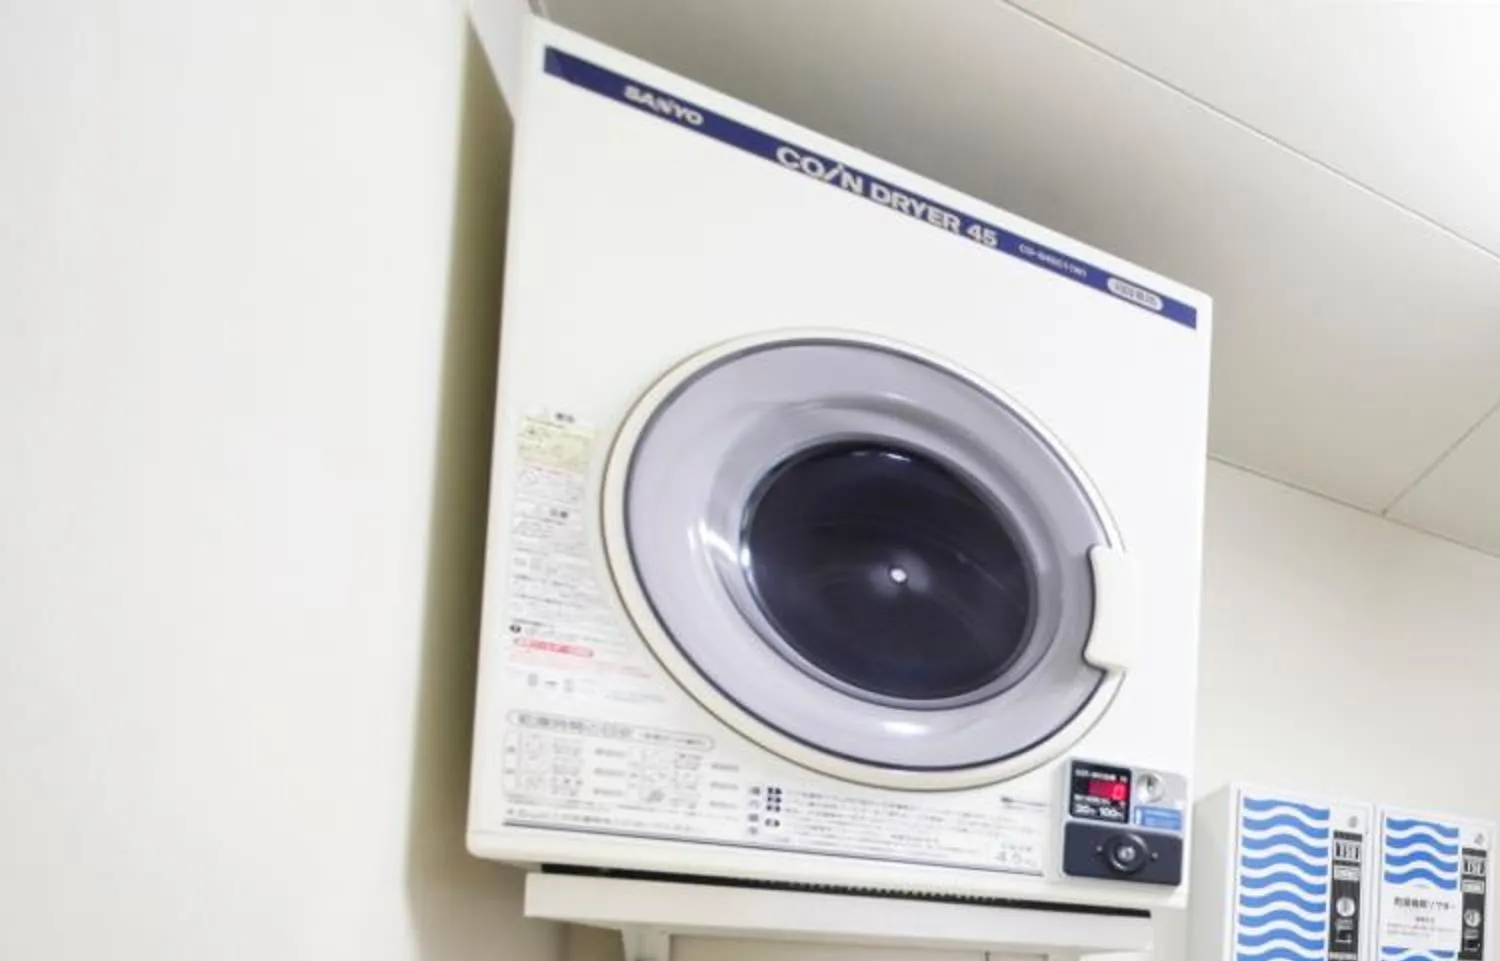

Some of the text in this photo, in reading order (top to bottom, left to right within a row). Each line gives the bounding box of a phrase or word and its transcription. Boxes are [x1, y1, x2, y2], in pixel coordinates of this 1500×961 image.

[624, 85, 704, 126] SANYO
[869, 181, 962, 236] DRYER
[967, 224, 998, 249] 45
